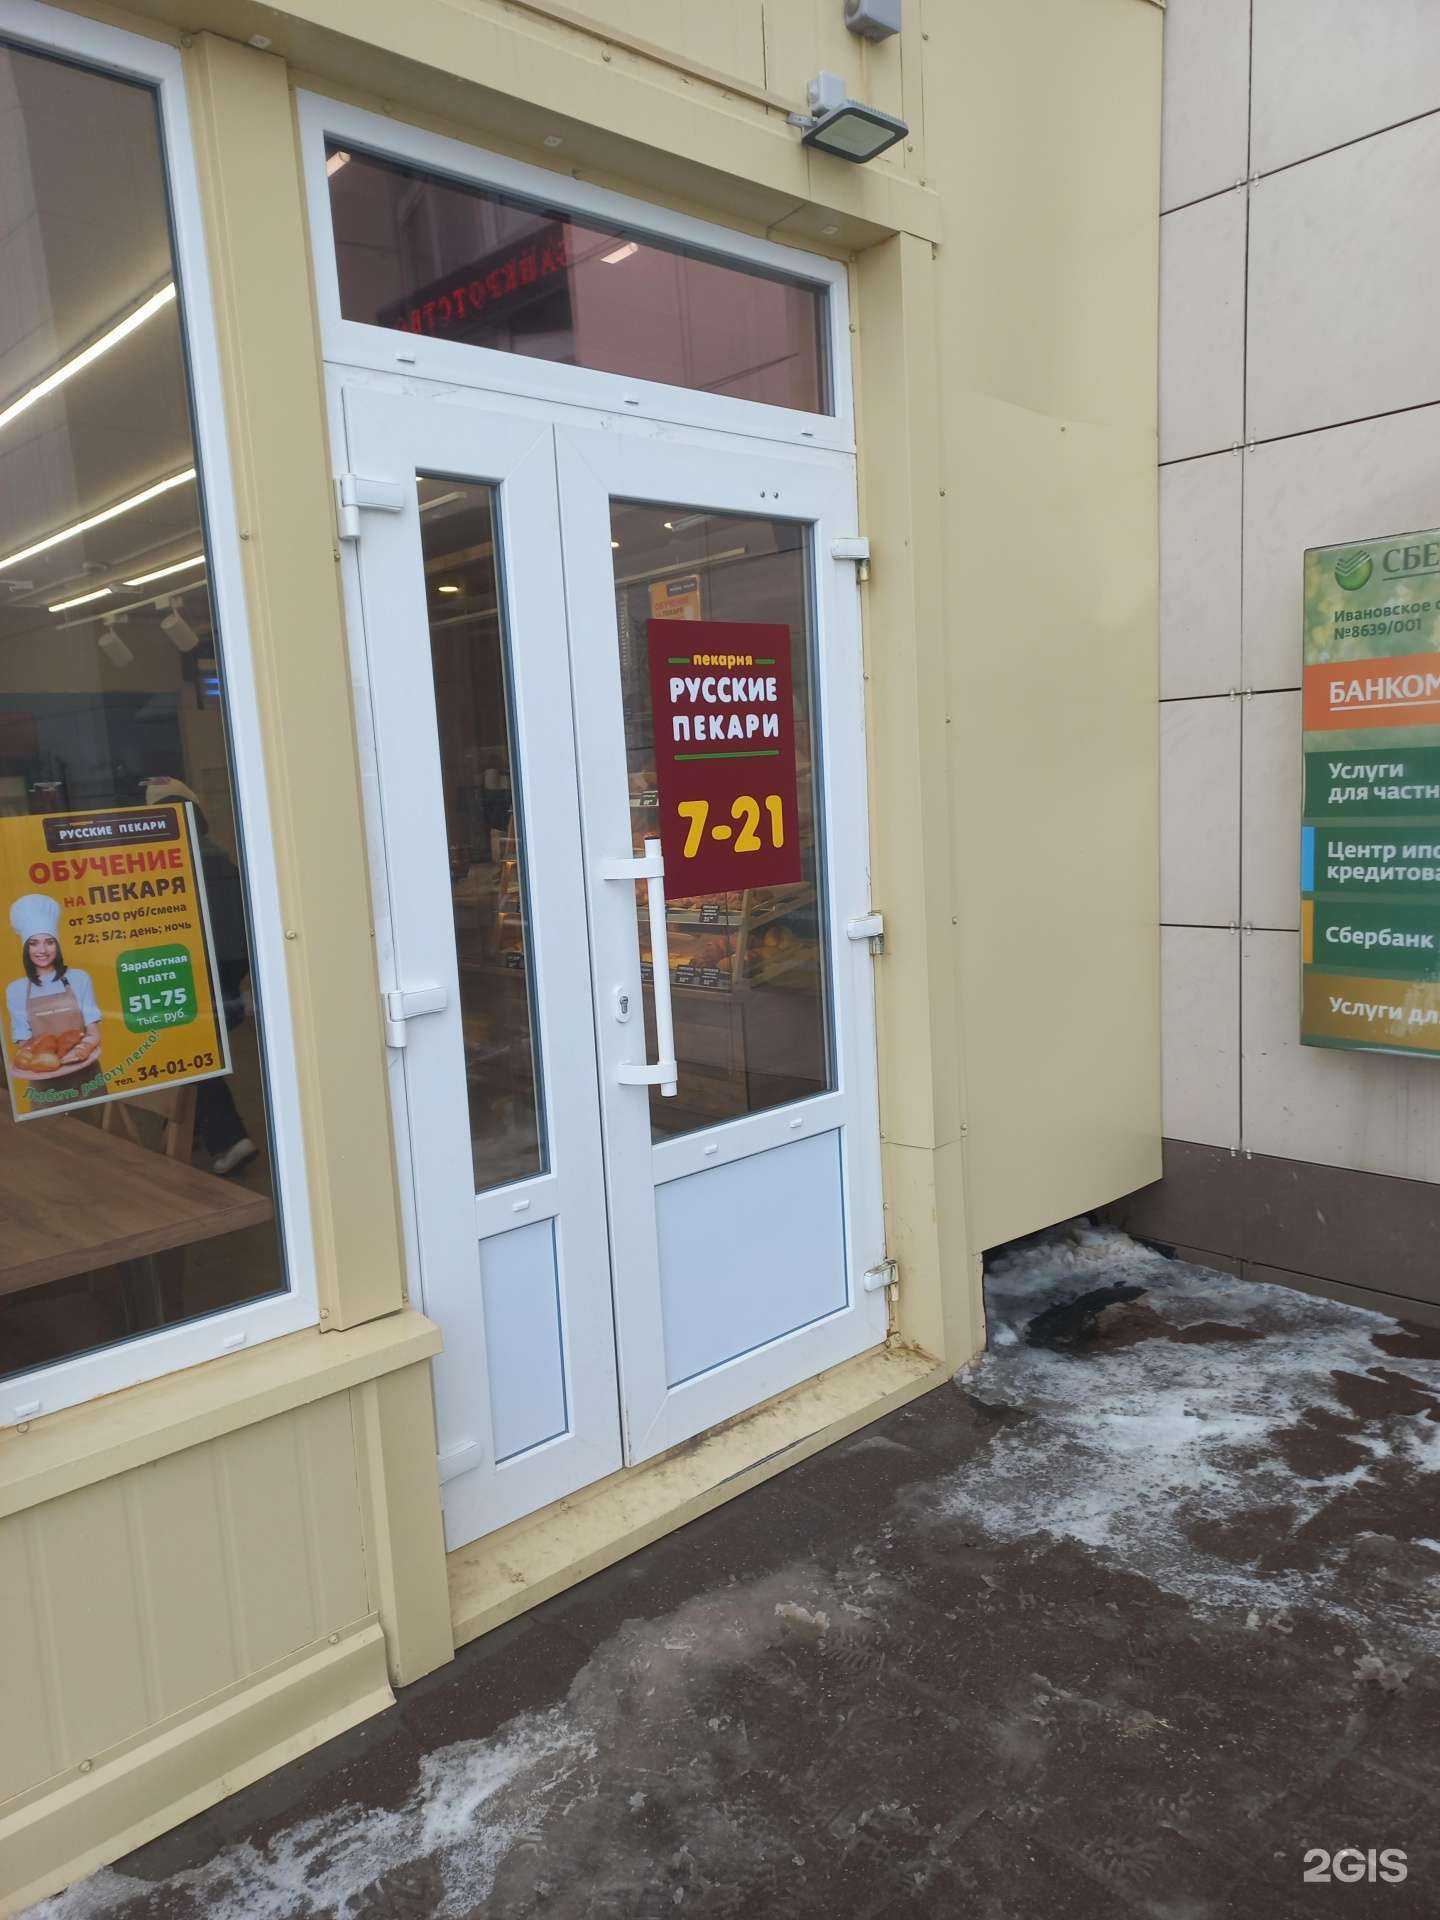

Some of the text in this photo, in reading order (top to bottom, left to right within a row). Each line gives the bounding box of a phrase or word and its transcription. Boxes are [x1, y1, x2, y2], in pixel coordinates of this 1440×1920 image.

[1383, 542, 1440, 573] СБЕ
[1334, 601, 1431, 622] Ивановское
[1334, 618, 1422, 640] №8639/001
[693, 654, 753, 669] пекарня
[669, 677, 778, 704] РУССКИЕ
[672, 713, 779, 742] ПЕКАРИ
[1328, 762, 1404, 783] Услуги
[1328, 786, 1369, 804] для
[59, 820, 167, 840] РУССКИЕ ПЕКАРИ
[677, 795, 785, 859] 7-21
[1328, 840, 1397, 863] Центр
[29, 848, 184, 885] ОБУЧЕНИЕ
[64, 876, 187, 908] НА ПЕКАРЯ
[68, 903, 187, 926] от 3500 руб/смена
[74, 922, 192, 946] 2/2; 5/2; день; ночь
[1326, 926, 1434, 949] Сбербанк
[120, 955, 188, 972] Заработная
[138, 971, 177, 985] плата
[129, 987, 187, 1013] 51-75
[1329, 996, 1440, 1026] Услуги дл
[164, 1007, 185, 1023] руб
[114, 1052, 215, 1088] тел. 34-01-03
